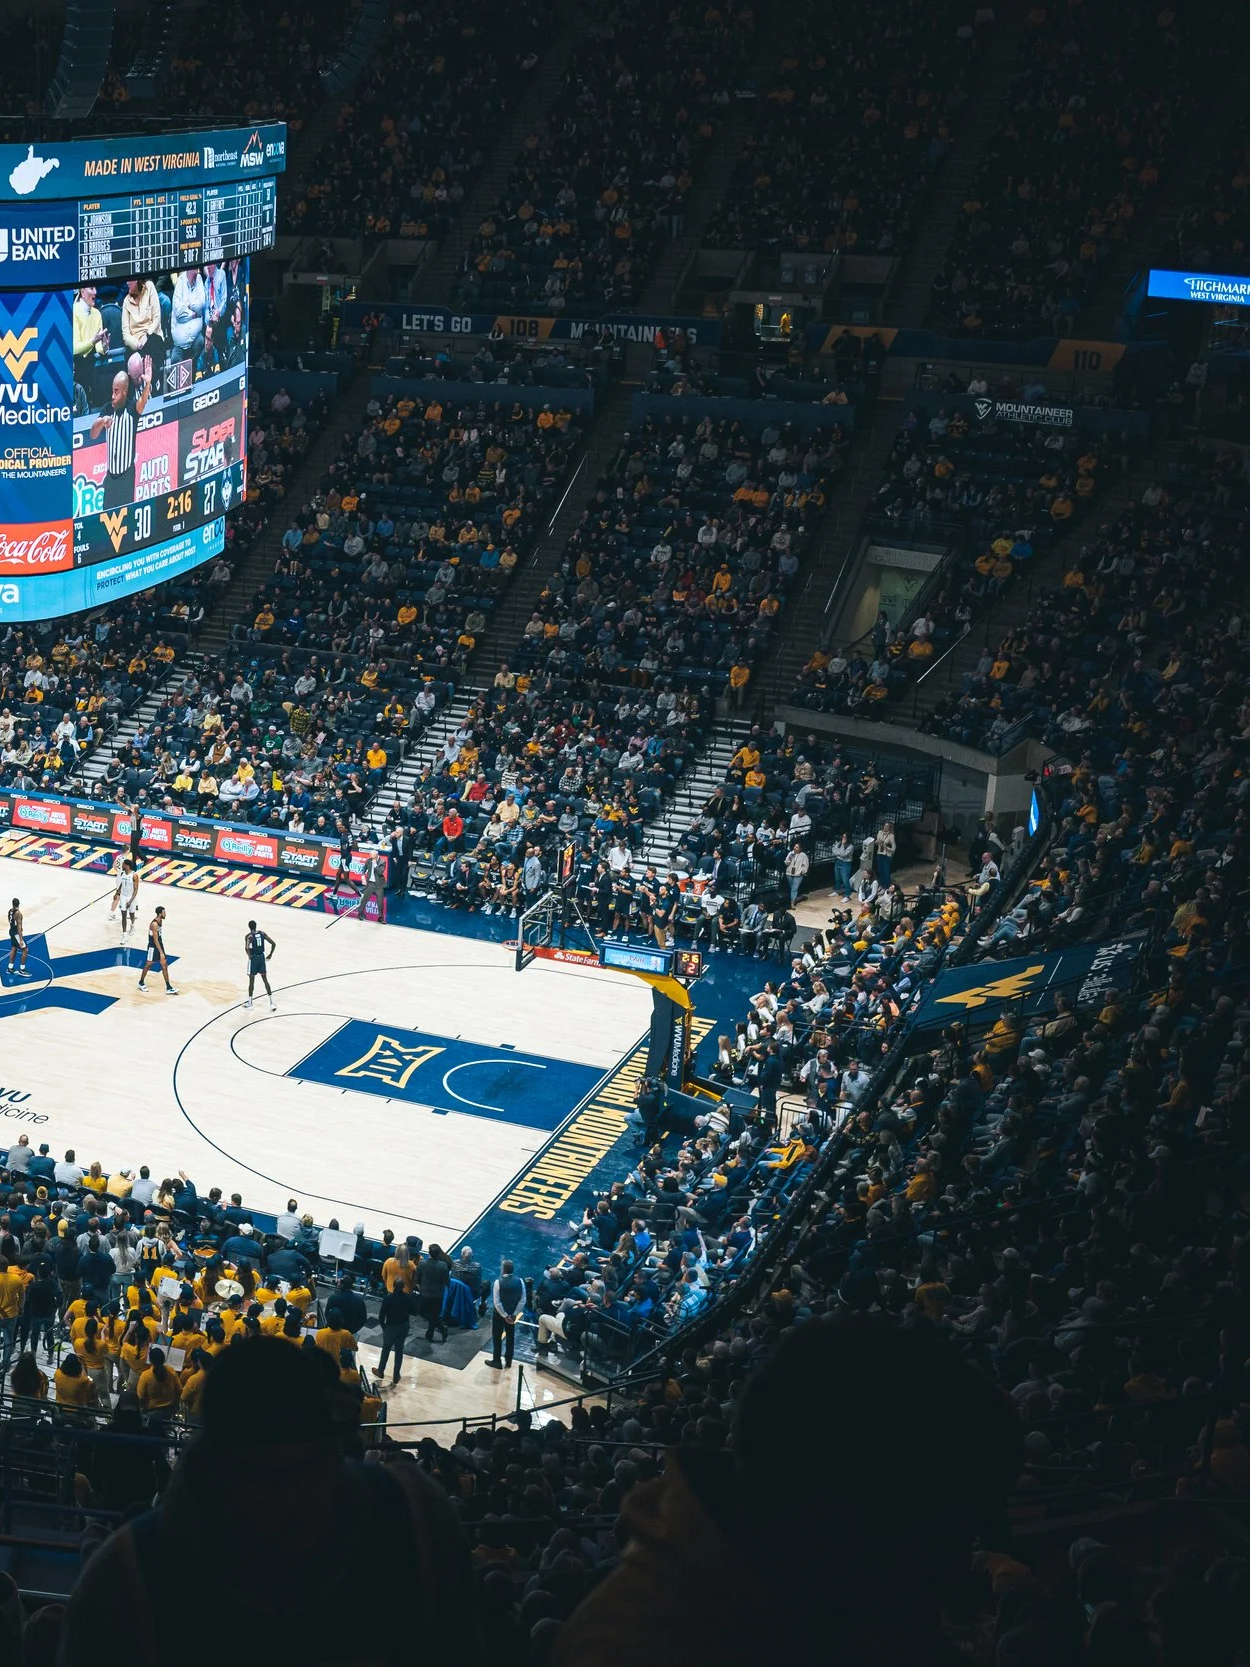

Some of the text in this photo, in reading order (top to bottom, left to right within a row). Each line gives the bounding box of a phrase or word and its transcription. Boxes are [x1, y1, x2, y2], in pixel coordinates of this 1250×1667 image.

[84, 152, 200, 177] MADE IN WEST VIRGINIA
[240, 151, 263, 167] MSW
[12, 226, 75, 244] UNITED
[12, 244, 60, 261] BANK
[1190, 291, 1245, 303] WEST VIRGINIA
[402, 314, 472, 333] LET'S GO
[193, 390, 220, 412] GEICO
[996, 402, 1073, 418] MOUNTAINEER
[4, 447, 55, 459] OFFICIAL
[29, 455, 71, 469] PROVIDER
[140, 454, 169, 482] AUTO
[1, 471, 15, 479] THE
[17, 468, 66, 478] MOUNTAINEERS
[135, 476, 171, 501] PARTS
[167, 490, 192, 519] 2:16
[203, 481, 216, 516] 27
[134, 504, 151, 541] 30
[96, 576, 125, 591] PROTECT
[175, 834, 211, 846] START
[281, 850, 318, 864] START
[564, 953, 582, 963] State
[498, 1104, 630, 1220] MOUNTAINEERS
[143, 1246, 157, 1260] 11
